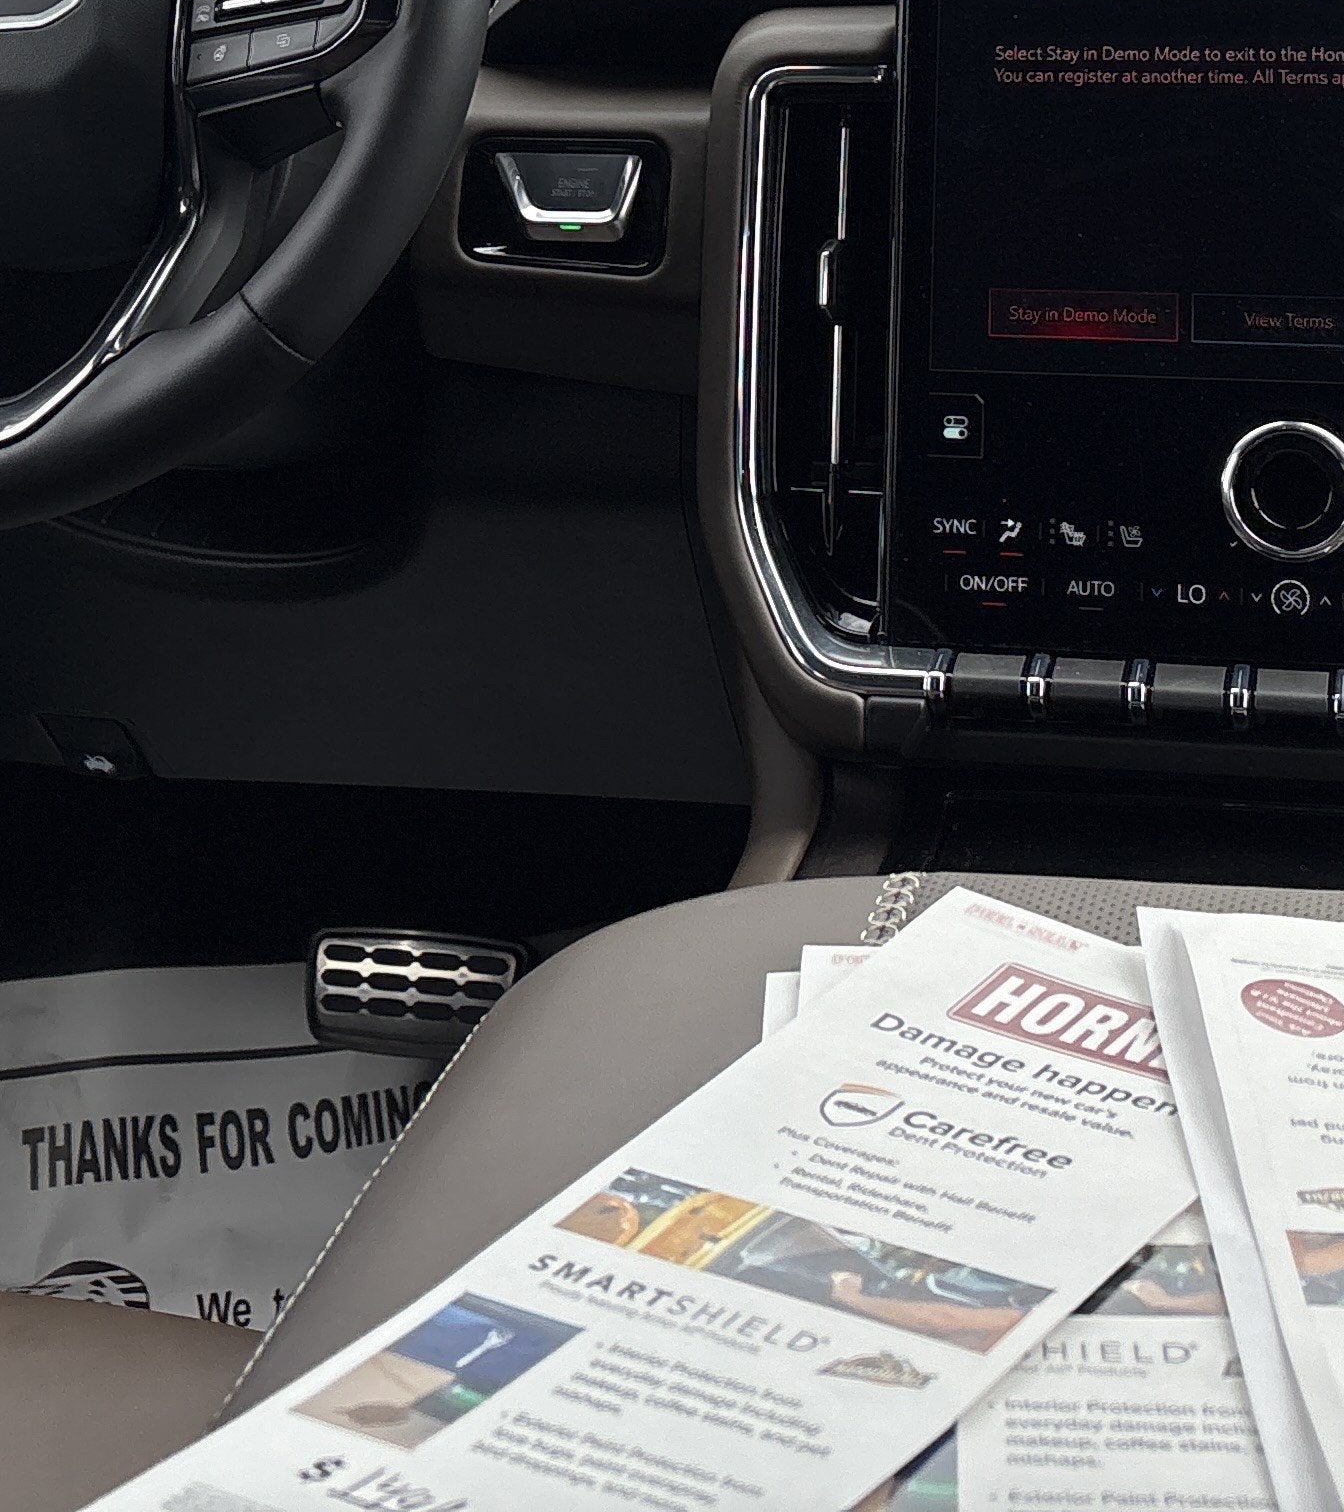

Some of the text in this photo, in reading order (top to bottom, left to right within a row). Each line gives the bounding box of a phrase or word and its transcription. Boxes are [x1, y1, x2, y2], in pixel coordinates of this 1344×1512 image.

[994, 46, 1043, 63] Select
[1046, 46, 1080, 66] Stay
[1083, 47, 1098, 63] in
[1101, 47, 1150, 64] Demo
[1154, 47, 1201, 64] Mode
[1205, 49, 1222, 64] to
[1225, 47, 1256, 64] exit
[1259, 49, 1277, 64] to
[1280, 47, 1308, 64] the
[994, 68, 1023, 85] You
[1026, 72, 1055, 85] can
[1058, 69, 1118, 88] register
[1121, 71, 1139, 85] at
[1141, 70, 1205, 85] another
[1208, 69, 1248, 85] time.
[1252, 69, 1274, 85] All
[1277, 69, 1329, 86] Terms
[1008, 305, 1157, 326] Stay in Demo Mode
[1244, 312, 1334, 330] View Terms
[932, 518, 977, 536] SYNC
[959, 575, 1028, 593] ON/OFF
[1066, 580, 1115, 598] AUTO
[1176, 584, 1206, 605] LO
[970, 975, 1164, 1072] HORN
[870, 1011, 1026, 1073] Damage
[918, 1055, 1119, 1120] Protect your new car's
[1286, 1076, 1329, 1090] from
[875, 1057, 1136, 1141] appearance and resale value.
[1289, 1117, 1319, 1129] pet
[21, 1112, 182, 1191] THANKS
[195, 1107, 276, 1174] FOR
[777, 1124, 900, 1169] Plus Coverages:
[887, 1125, 1048, 1179] Dent Protection
[902, 1110, 1074, 1171] Carefree
[808, 1152, 1037, 1225] Dent Repair with Hail Benefit
[778, 1175, 954, 1234] Transportation Benefit
[195, 1289, 252, 1328] We
[1024, 1339, 1192, 1367] HIELD
[297, 1453, 347, 1484] $
